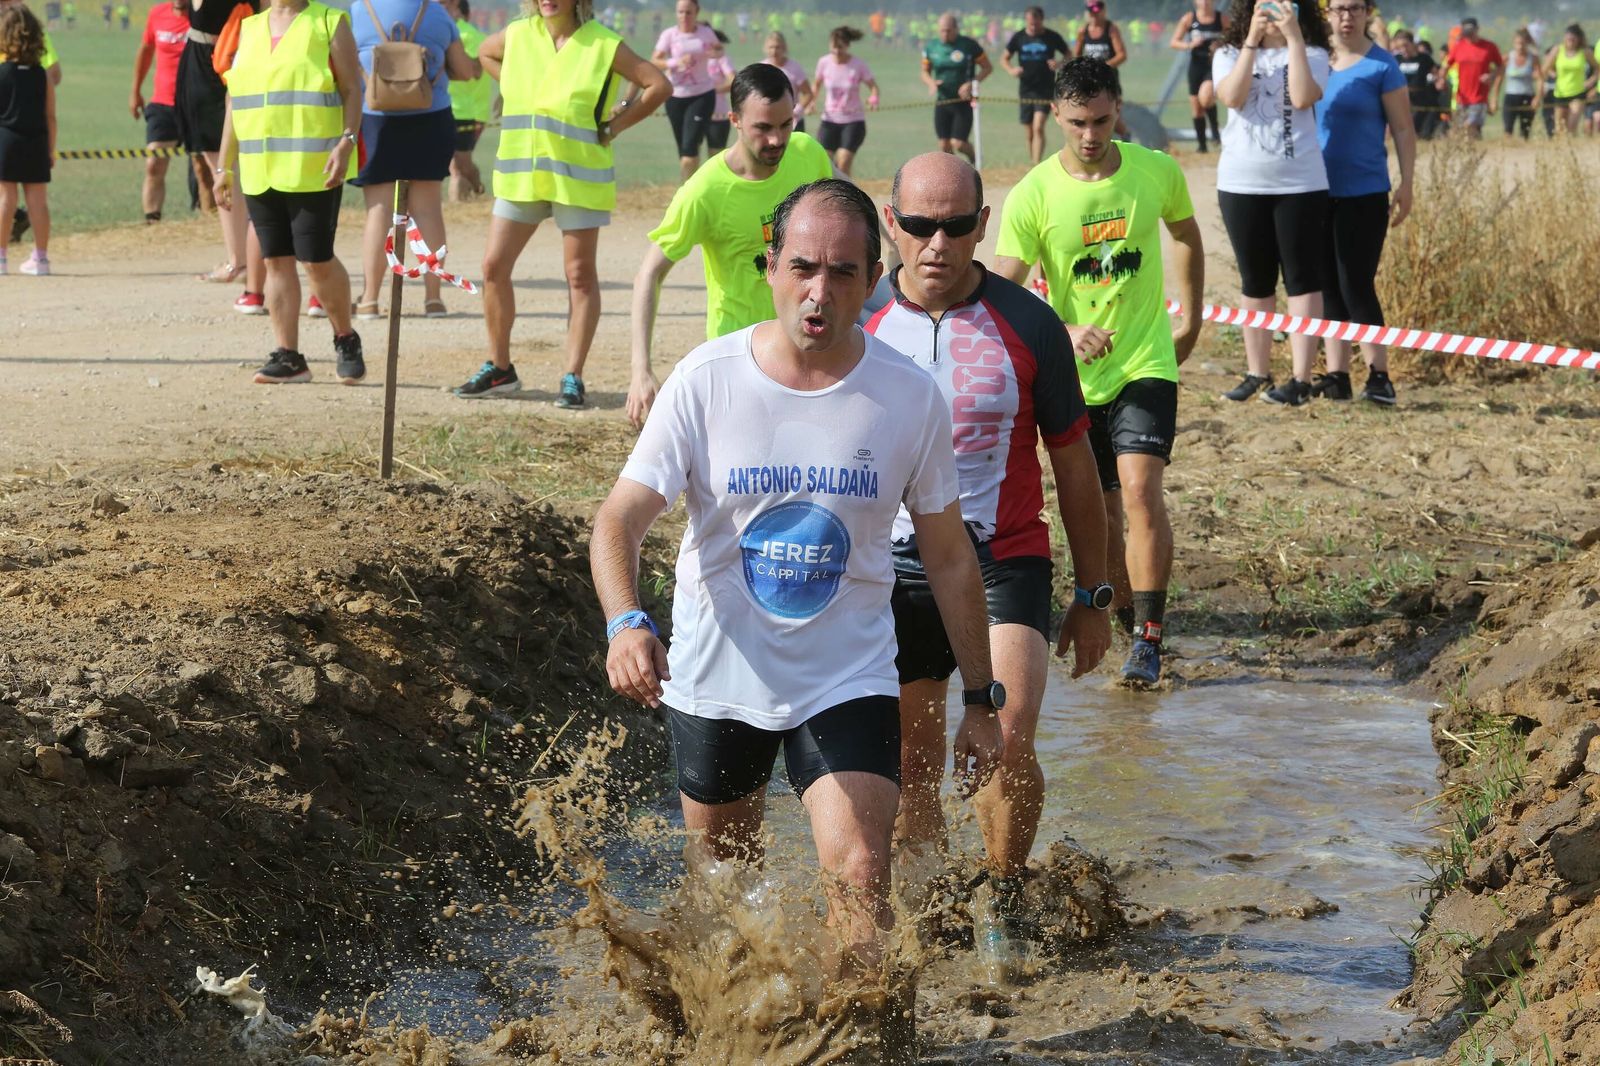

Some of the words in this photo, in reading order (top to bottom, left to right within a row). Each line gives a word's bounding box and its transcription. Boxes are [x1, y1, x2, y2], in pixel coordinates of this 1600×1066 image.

[1083, 218, 1126, 245] BARRO
[727, 465, 802, 495] ANTONIO
[806, 464, 878, 499] SALDAÑA
[758, 540, 833, 564] JEREZ
[756, 563, 829, 582] CAPPITAL
